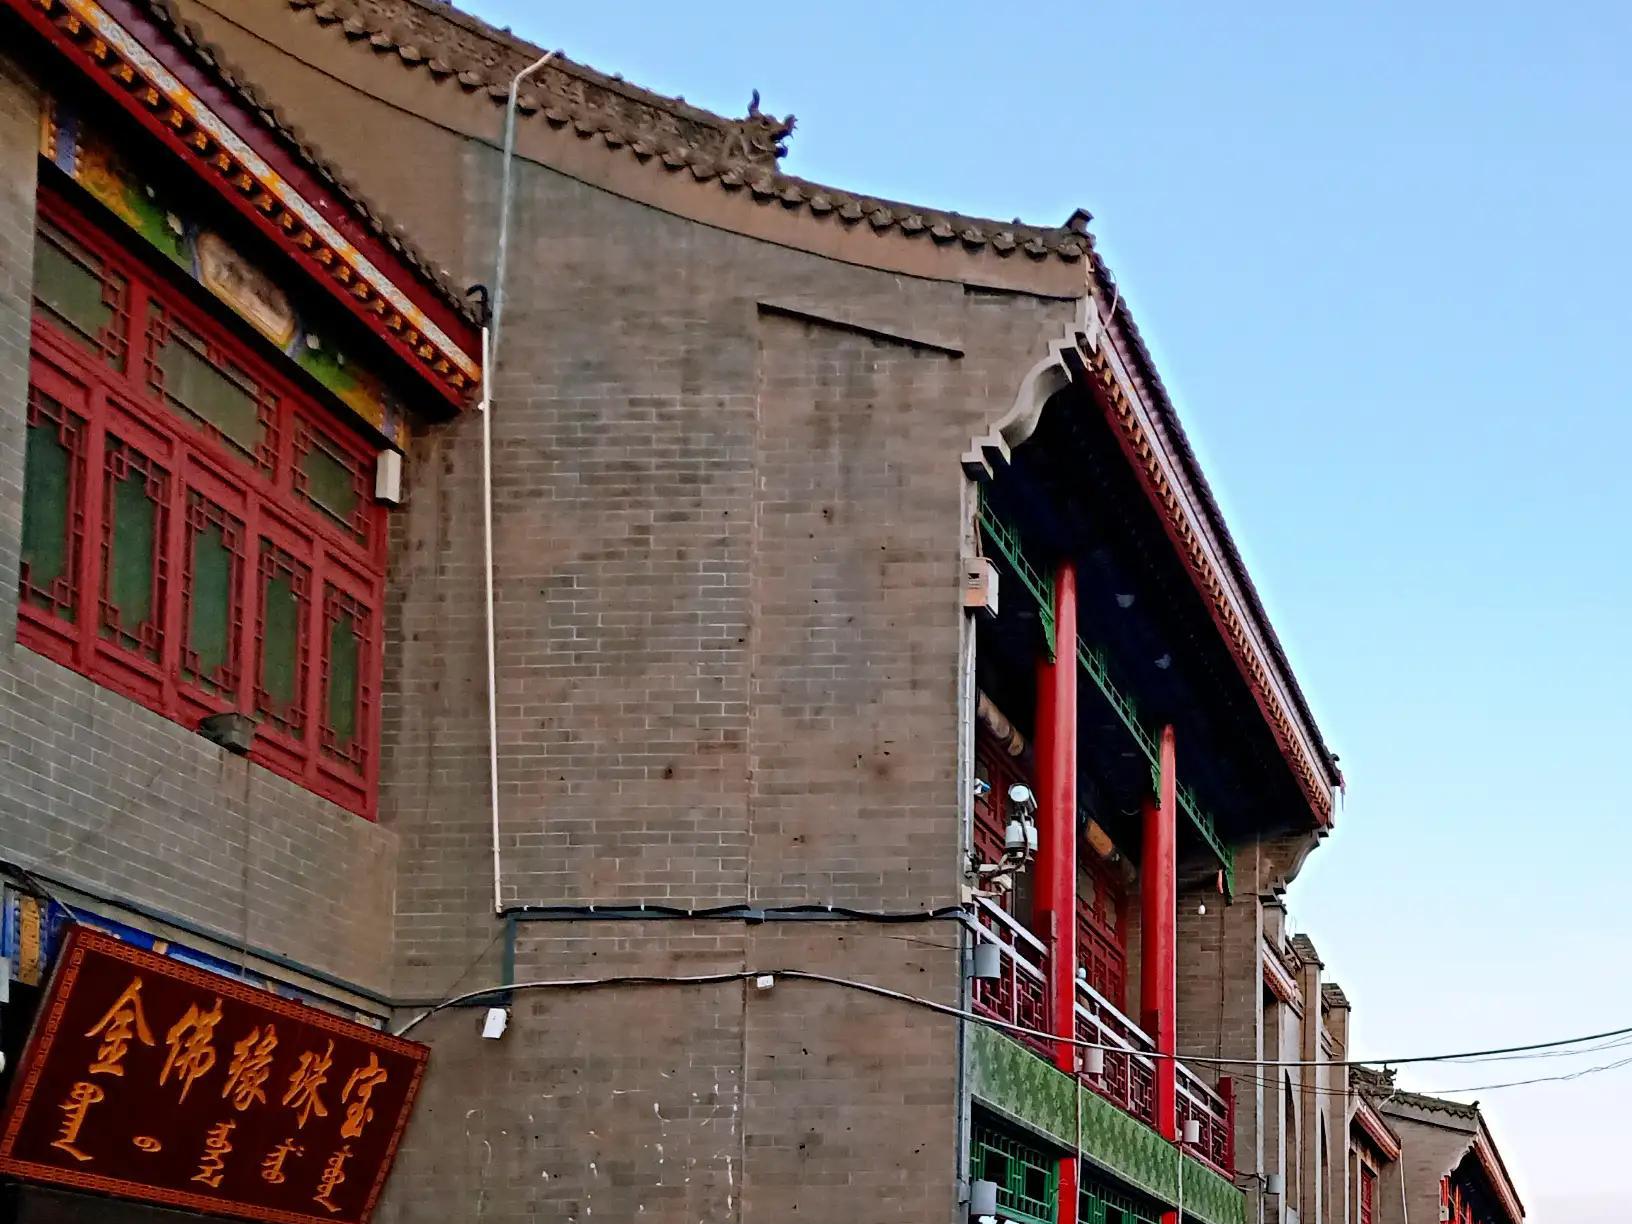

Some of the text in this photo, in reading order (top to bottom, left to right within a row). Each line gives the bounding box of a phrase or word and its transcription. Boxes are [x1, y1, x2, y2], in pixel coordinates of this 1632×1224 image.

[84, 976, 390, 1142] 金佛缘珠宝
